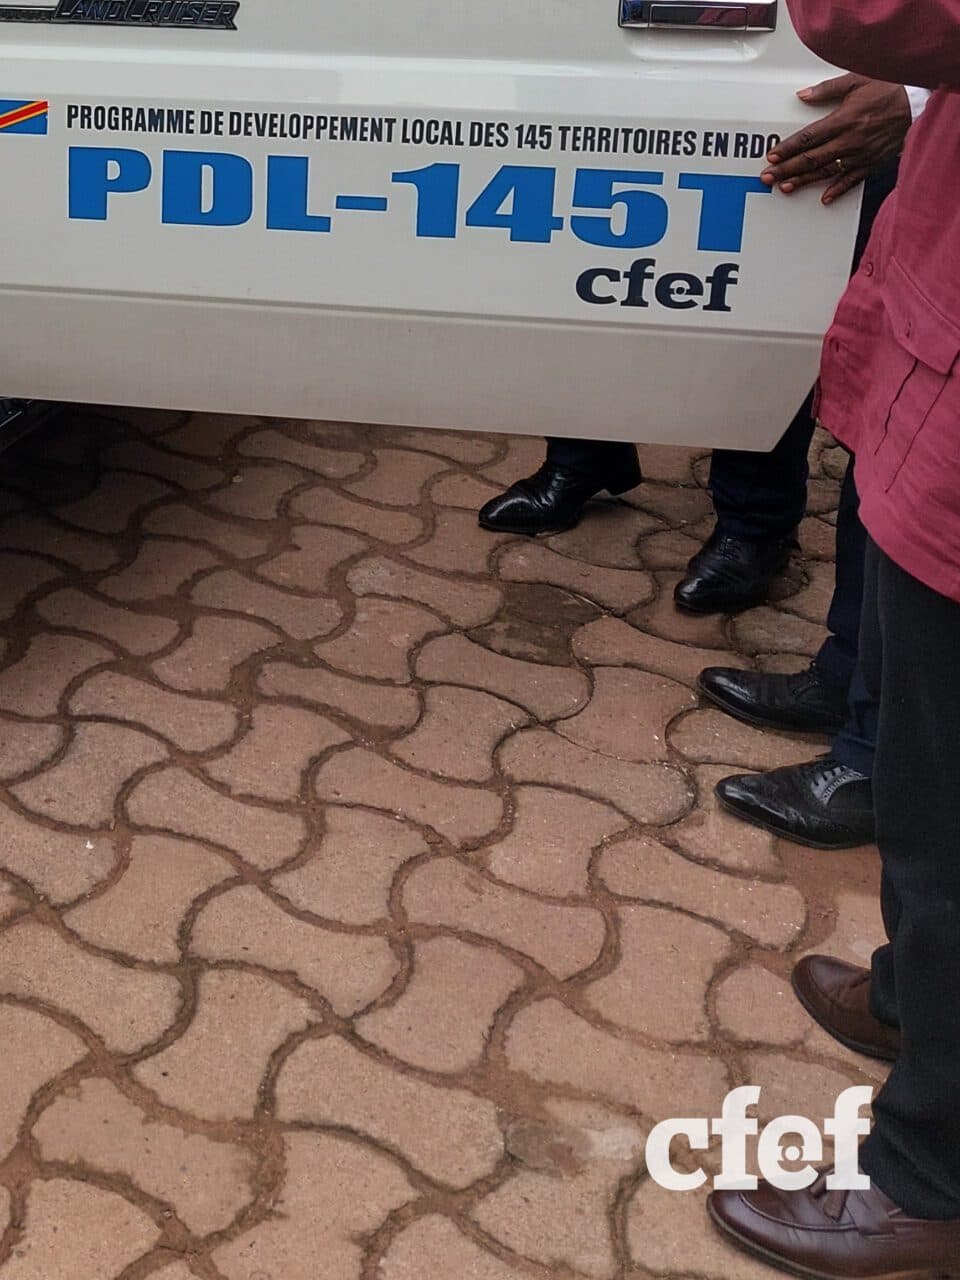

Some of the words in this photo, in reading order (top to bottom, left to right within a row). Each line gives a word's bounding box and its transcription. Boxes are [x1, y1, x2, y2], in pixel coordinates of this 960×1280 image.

[66, 104, 195, 135] PROGRAMME
[199, 110, 225, 136] DE
[228, 112, 397, 143] DEVELOPPEMENT
[400, 118, 465, 147] LOCAL
[468, 121, 510, 149] DES
[514, 123, 553, 151] 145
[557, 125, 697, 156] TERRITOIRES
[701, 131, 731, 158] EN
[67, 146, 773, 253] PDL-145T
[575, 257, 740, 313] cfef
